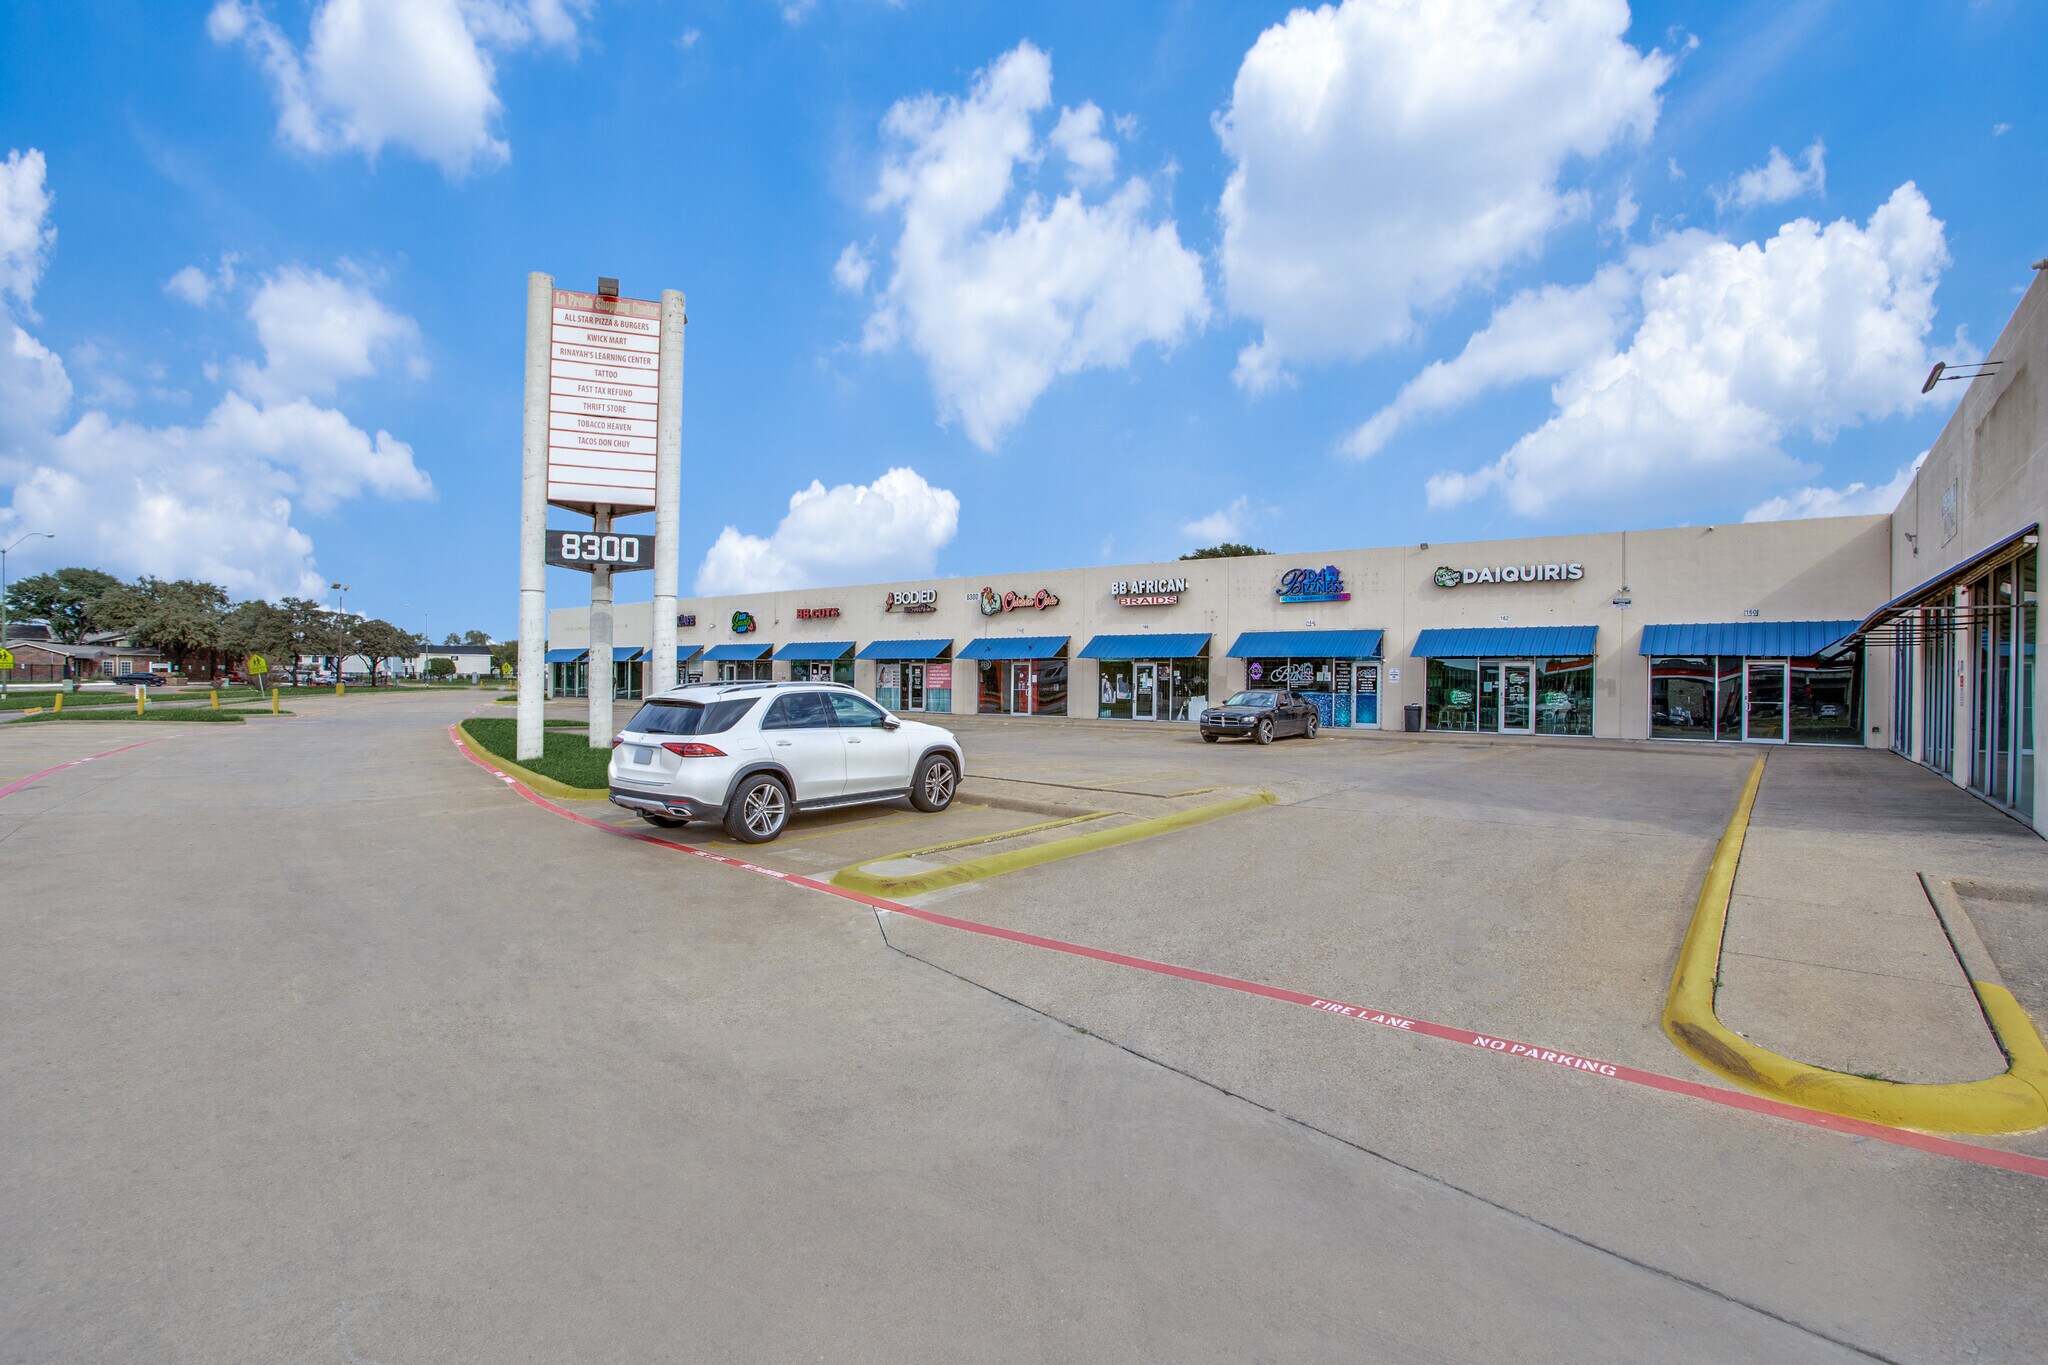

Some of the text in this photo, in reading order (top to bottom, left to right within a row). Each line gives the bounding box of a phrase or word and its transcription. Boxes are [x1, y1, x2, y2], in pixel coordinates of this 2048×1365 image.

[564, 313, 576, 322] ALL
[577, 315, 594, 324] STAR
[595, 317, 613, 327] PIZZA
[620, 320, 650, 331] BURGERS
[586, 333, 627, 345] KWICK MART
[560, 348, 652, 365] RINAYAH'S LEARNING CENTER
[594, 369, 618, 378] TATTOO
[578, 385, 633, 397] FAST TAX REFUND
[583, 403, 627, 413] THRIFT STORE
[577, 420, 632, 431] TOBACCO HEAVEN
[578, 437, 631, 448] TACOS DON CHUY
[561, 533, 639, 562] 8300
[1463, 563, 1583, 584] DAIQUIRIS
[1111, 578, 1185, 595] BB AFRICAN
[894, 589, 937, 604] BODIED
[1119, 596, 1177, 605] BRAIDS
[797, 607, 839, 619] BB CUTS
[1310, 999, 1416, 1030] FIRE LANE
[1473, 1035, 1617, 1077] NO PARKING
